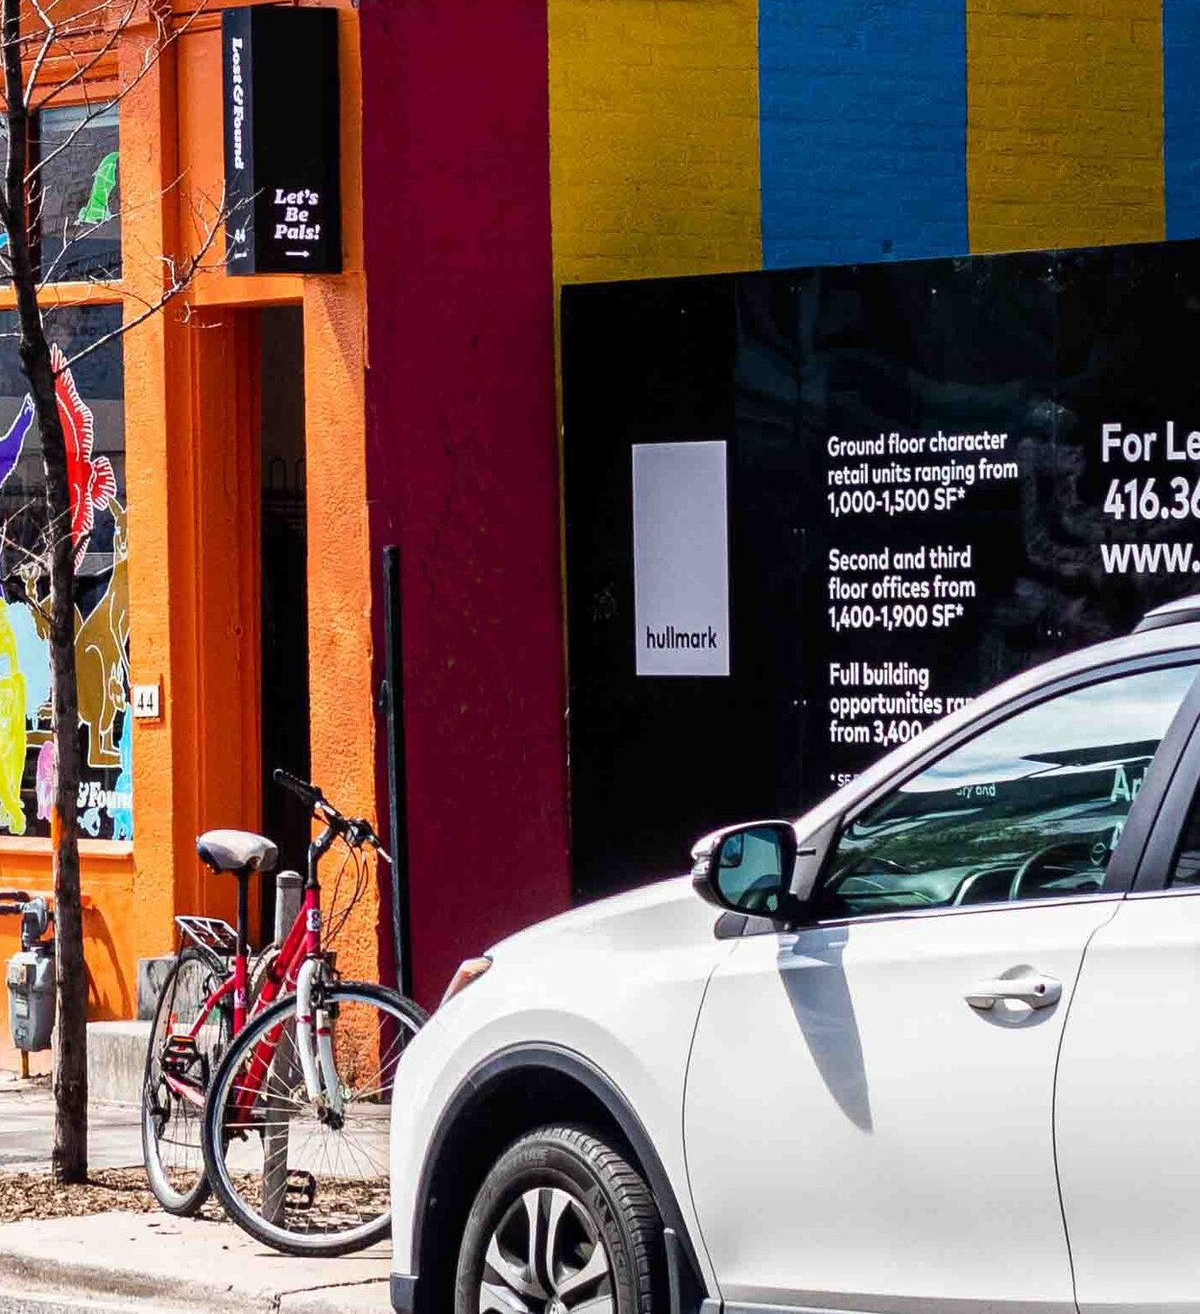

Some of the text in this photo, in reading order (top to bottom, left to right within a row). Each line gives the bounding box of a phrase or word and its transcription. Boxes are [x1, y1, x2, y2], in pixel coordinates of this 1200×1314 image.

[273, 188, 320, 206] Let's
[284, 207, 310, 223] Be
[273, 224, 322, 241] Pals!
[827, 430, 1008, 457] Ground floor character
[1102, 423, 1157, 463] For
[827, 457, 1019, 487] retail units ranging from
[827, 487, 930, 518] 1,000-1,500
[828, 544, 972, 571] Second and third
[828, 574, 977, 600] floor offices from
[828, 604, 929, 633] 1,400-1,900
[646, 625, 718, 649] hullmark
[829, 662, 930, 690] Full building
[137, 692, 154, 711] 44
[829, 690, 943, 720] opportunities
[829, 719, 870, 744] from
